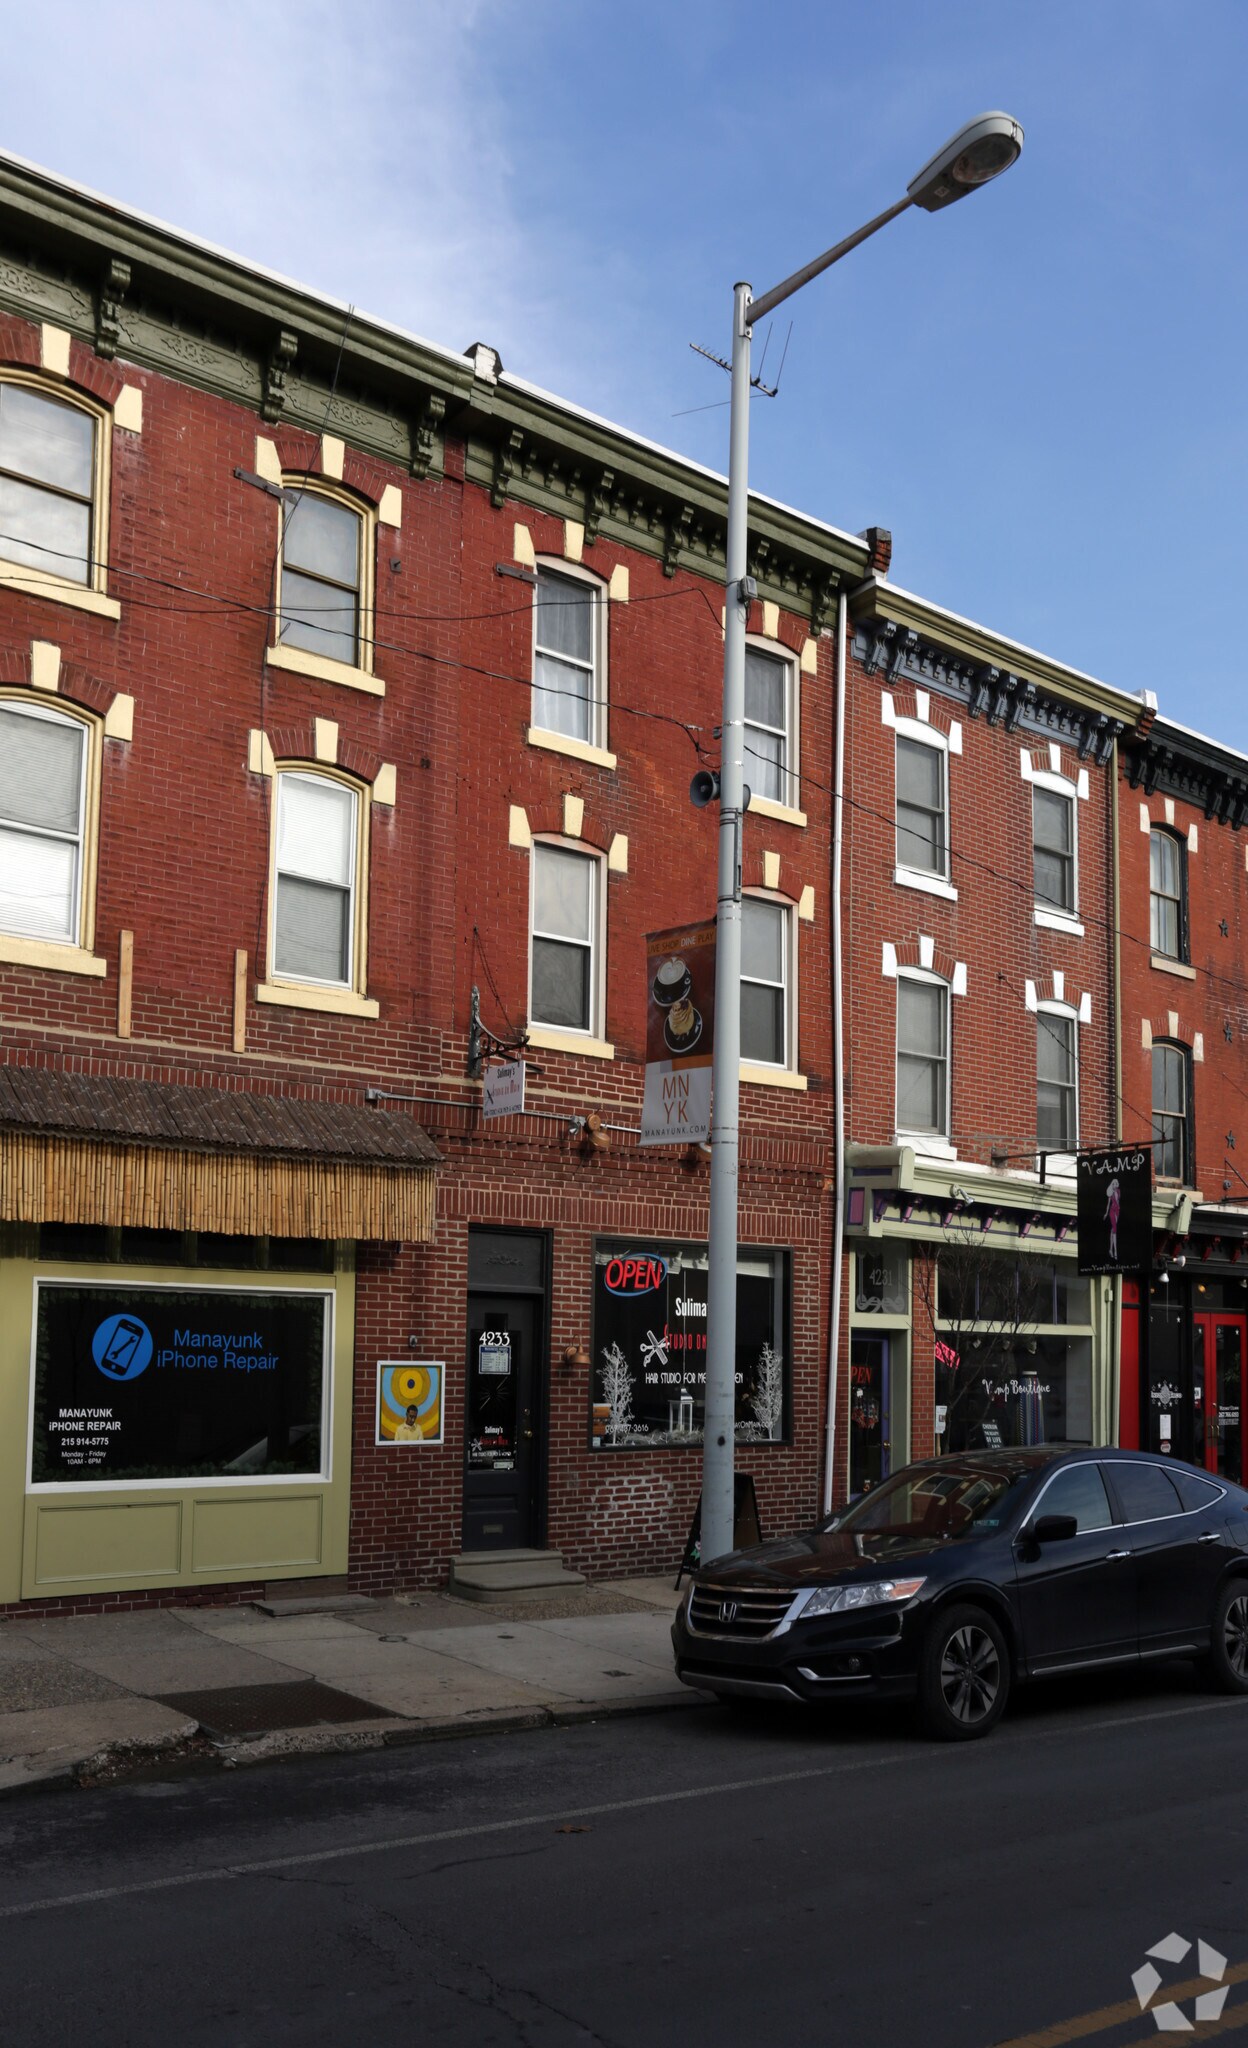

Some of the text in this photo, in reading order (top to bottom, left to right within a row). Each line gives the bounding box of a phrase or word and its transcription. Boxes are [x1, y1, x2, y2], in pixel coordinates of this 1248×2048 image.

[681, 935, 696, 947] DINE
[698, 930, 714, 944] PLAY
[662, 1073, 689, 1100] MN
[664, 1100, 689, 1124] YK
[644, 1124, 707, 1137] MANAYUNK.COM
[1082, 1153, 1145, 1175] VAMP
[605, 1258, 662, 1289] OPEN
[869, 1268, 892, 1286] 4231
[675, 1297, 708, 1317] Sulima
[173, 1329, 263, 1352] Manayunk
[479, 1331, 510, 1346] 4233
[157, 1350, 279, 1373] iPhone Repair
[645, 1372, 707, 1384] HAIR STUDIO FOR ME
[850, 1365, 873, 1384] PEN
[1010, 1379, 1051, 1401] Boutique
[59, 1408, 113, 1418] MANAYUNK
[48, 1421, 121, 1431] iPHONE REPAIR
[61, 1437, 109, 1446] 215 914-5775
[89, 1450, 107, 1458] Friday
